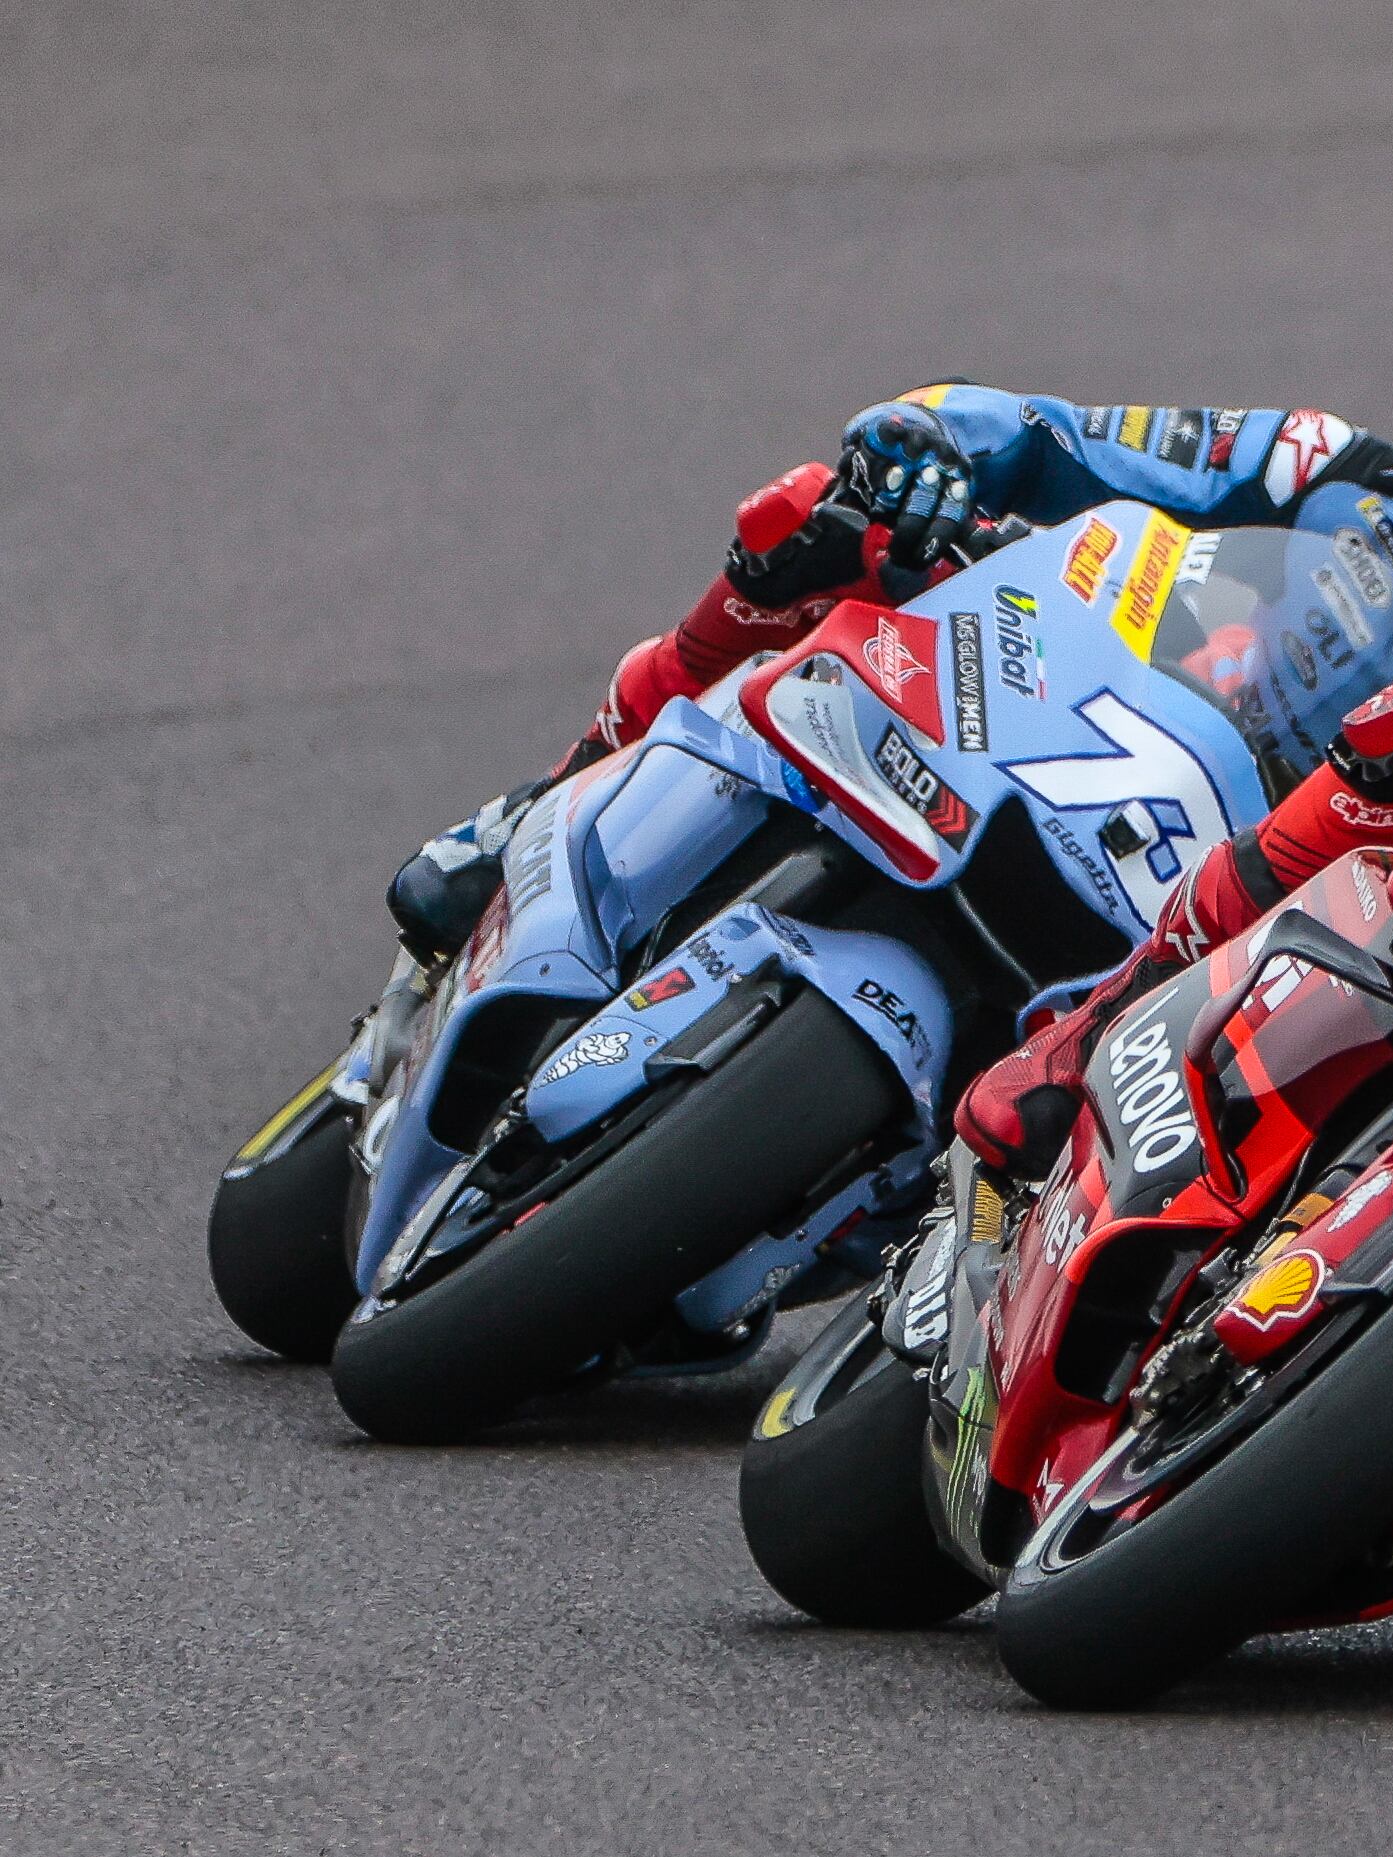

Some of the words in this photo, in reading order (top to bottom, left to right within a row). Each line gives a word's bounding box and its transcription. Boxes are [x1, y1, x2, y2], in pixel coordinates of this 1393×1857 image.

[1126, 525, 1176, 630] Antangin
[995, 584, 1037, 699] Unibat
[878, 731, 938, 803] BOLD
[1108, 986, 1198, 1174] Lenovo
